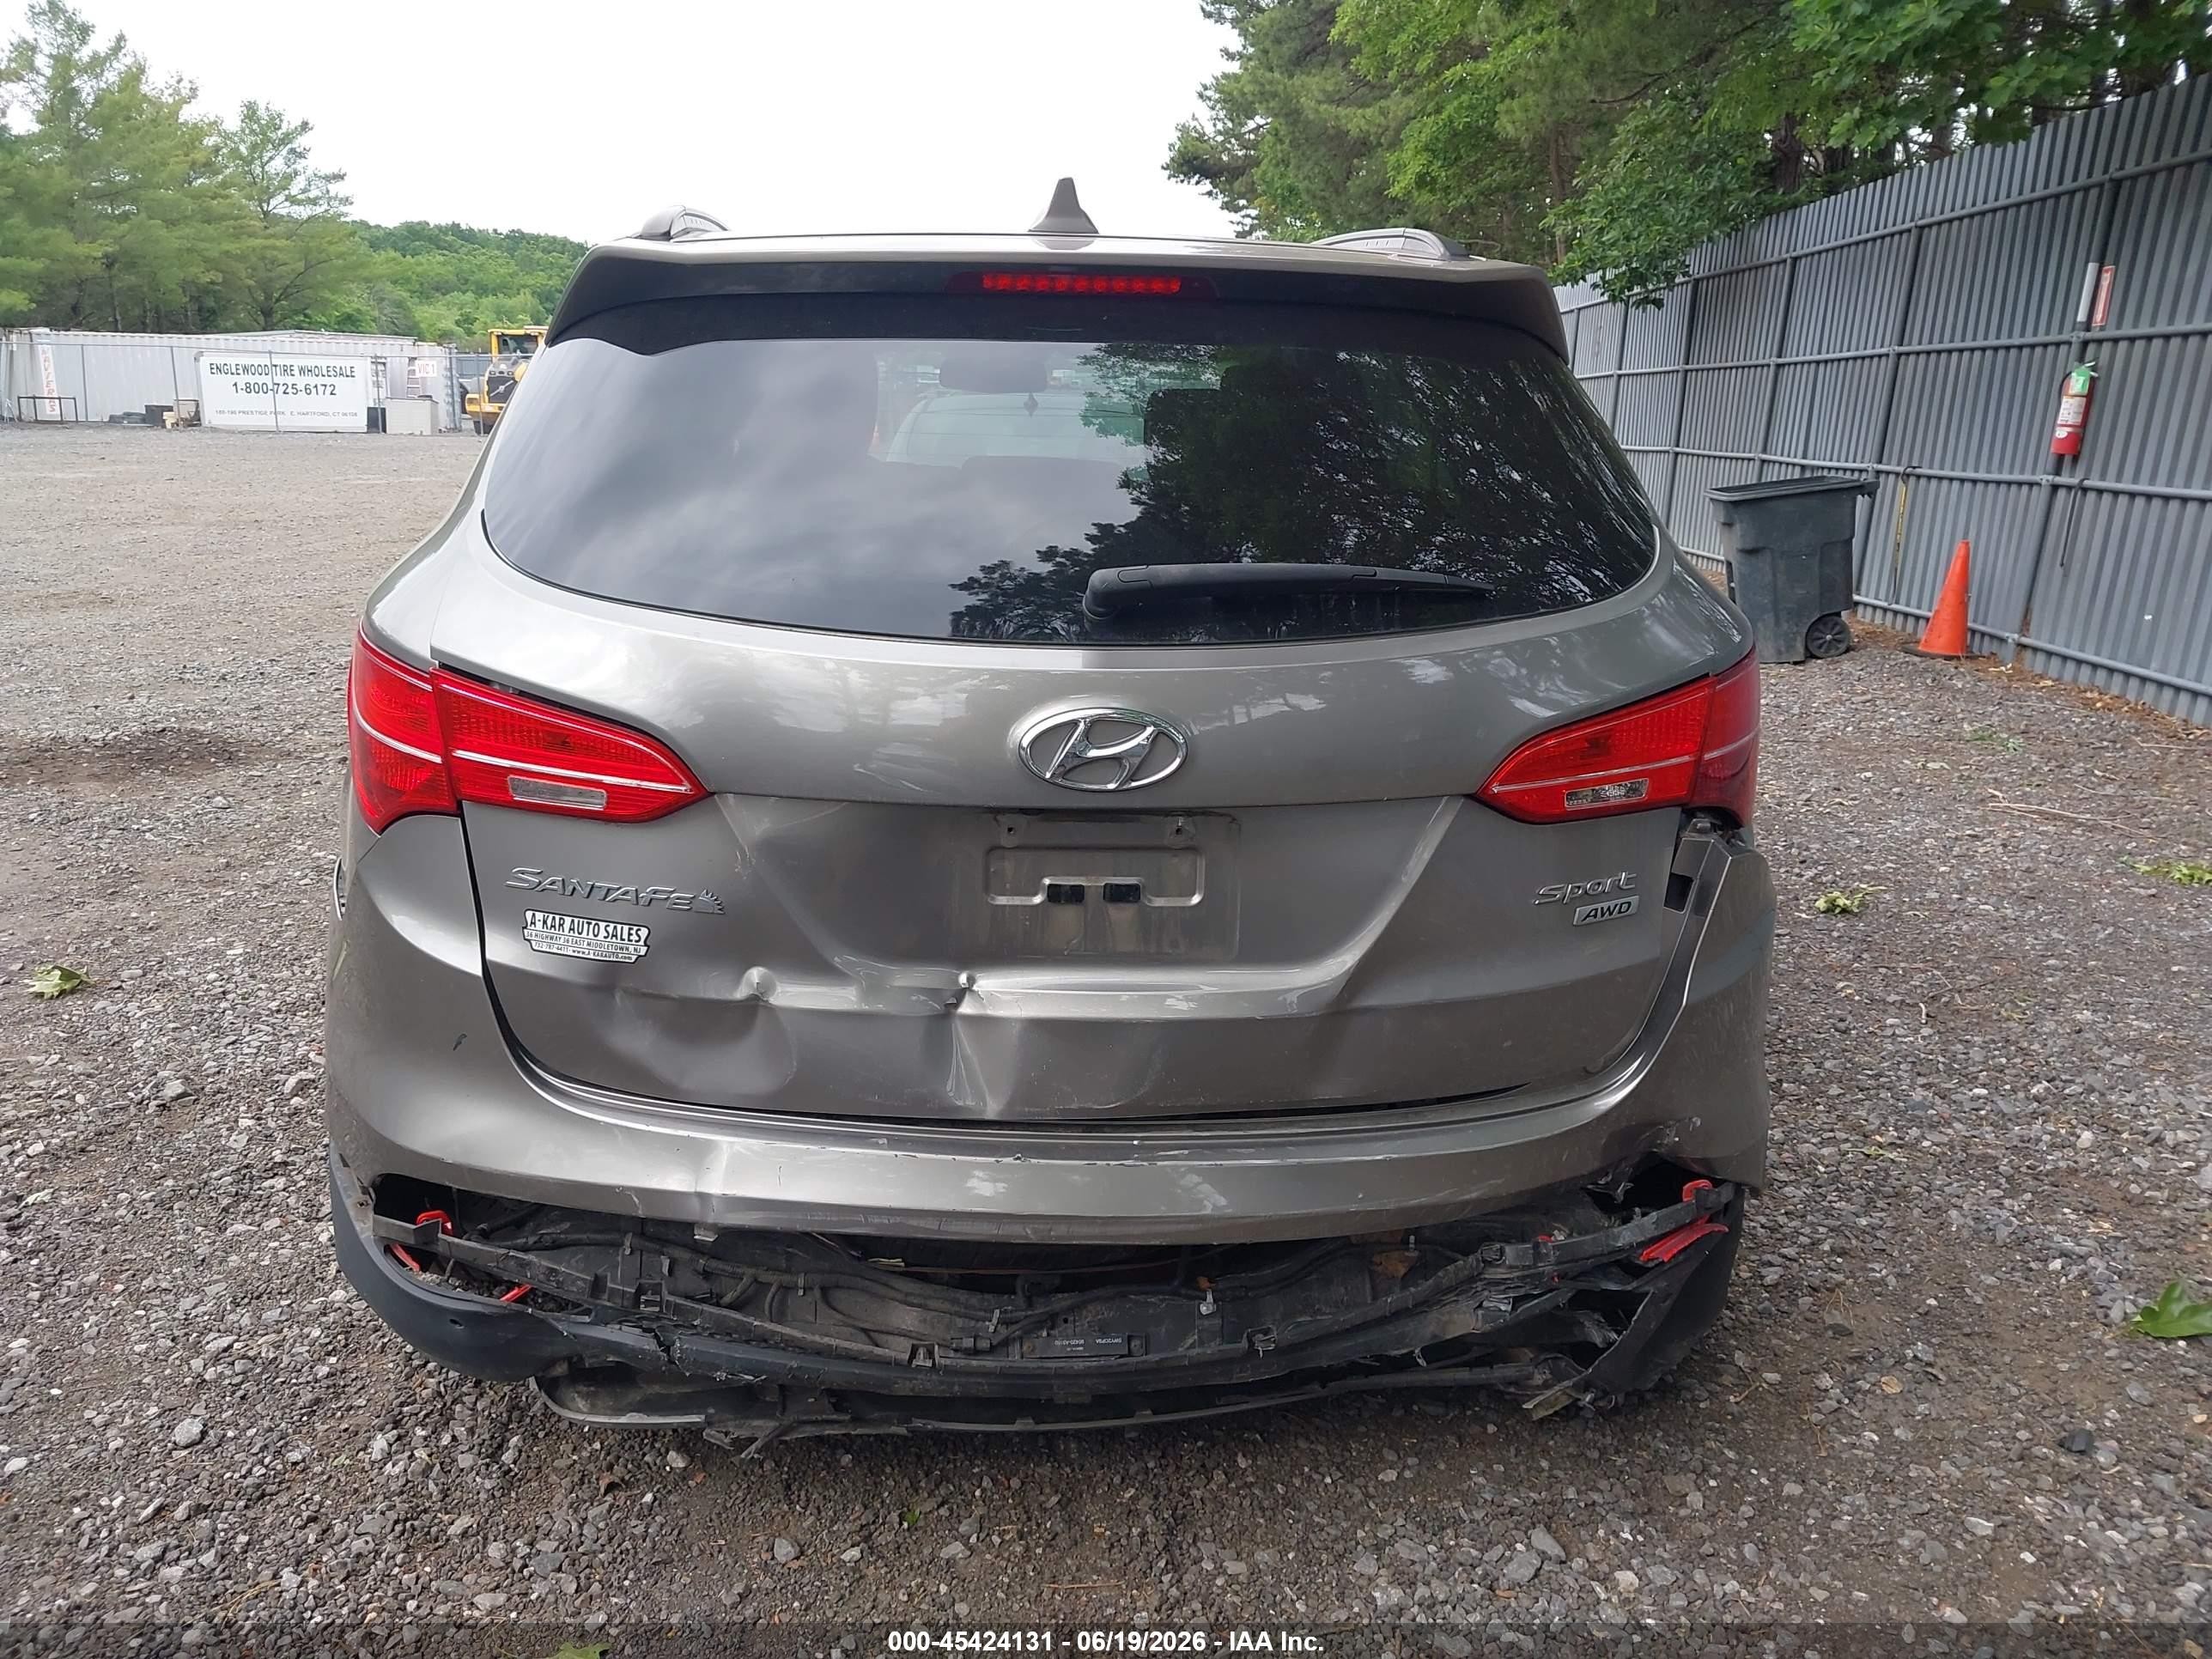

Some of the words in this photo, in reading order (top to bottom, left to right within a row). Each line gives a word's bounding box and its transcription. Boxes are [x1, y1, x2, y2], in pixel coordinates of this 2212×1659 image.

[210, 362, 270, 376] ENGLEWOOD
[272, 364, 295, 377] TIRE
[297, 364, 356, 378] WHOLESALE
[232, 381, 337, 396] 1-800-725-6172
[1534, 872, 1637, 905] Sport
[1581, 901, 1632, 922] AWD
[530, 912, 566, 933] A-KAR
[568, 918, 600, 938] AUTO
[603, 924, 642, 943] SALES
[534, 932, 562, 944] HIGHWAY
[570, 938, 586, 947] EAST
[586, 940, 633, 953] MIDDLETOWN,
